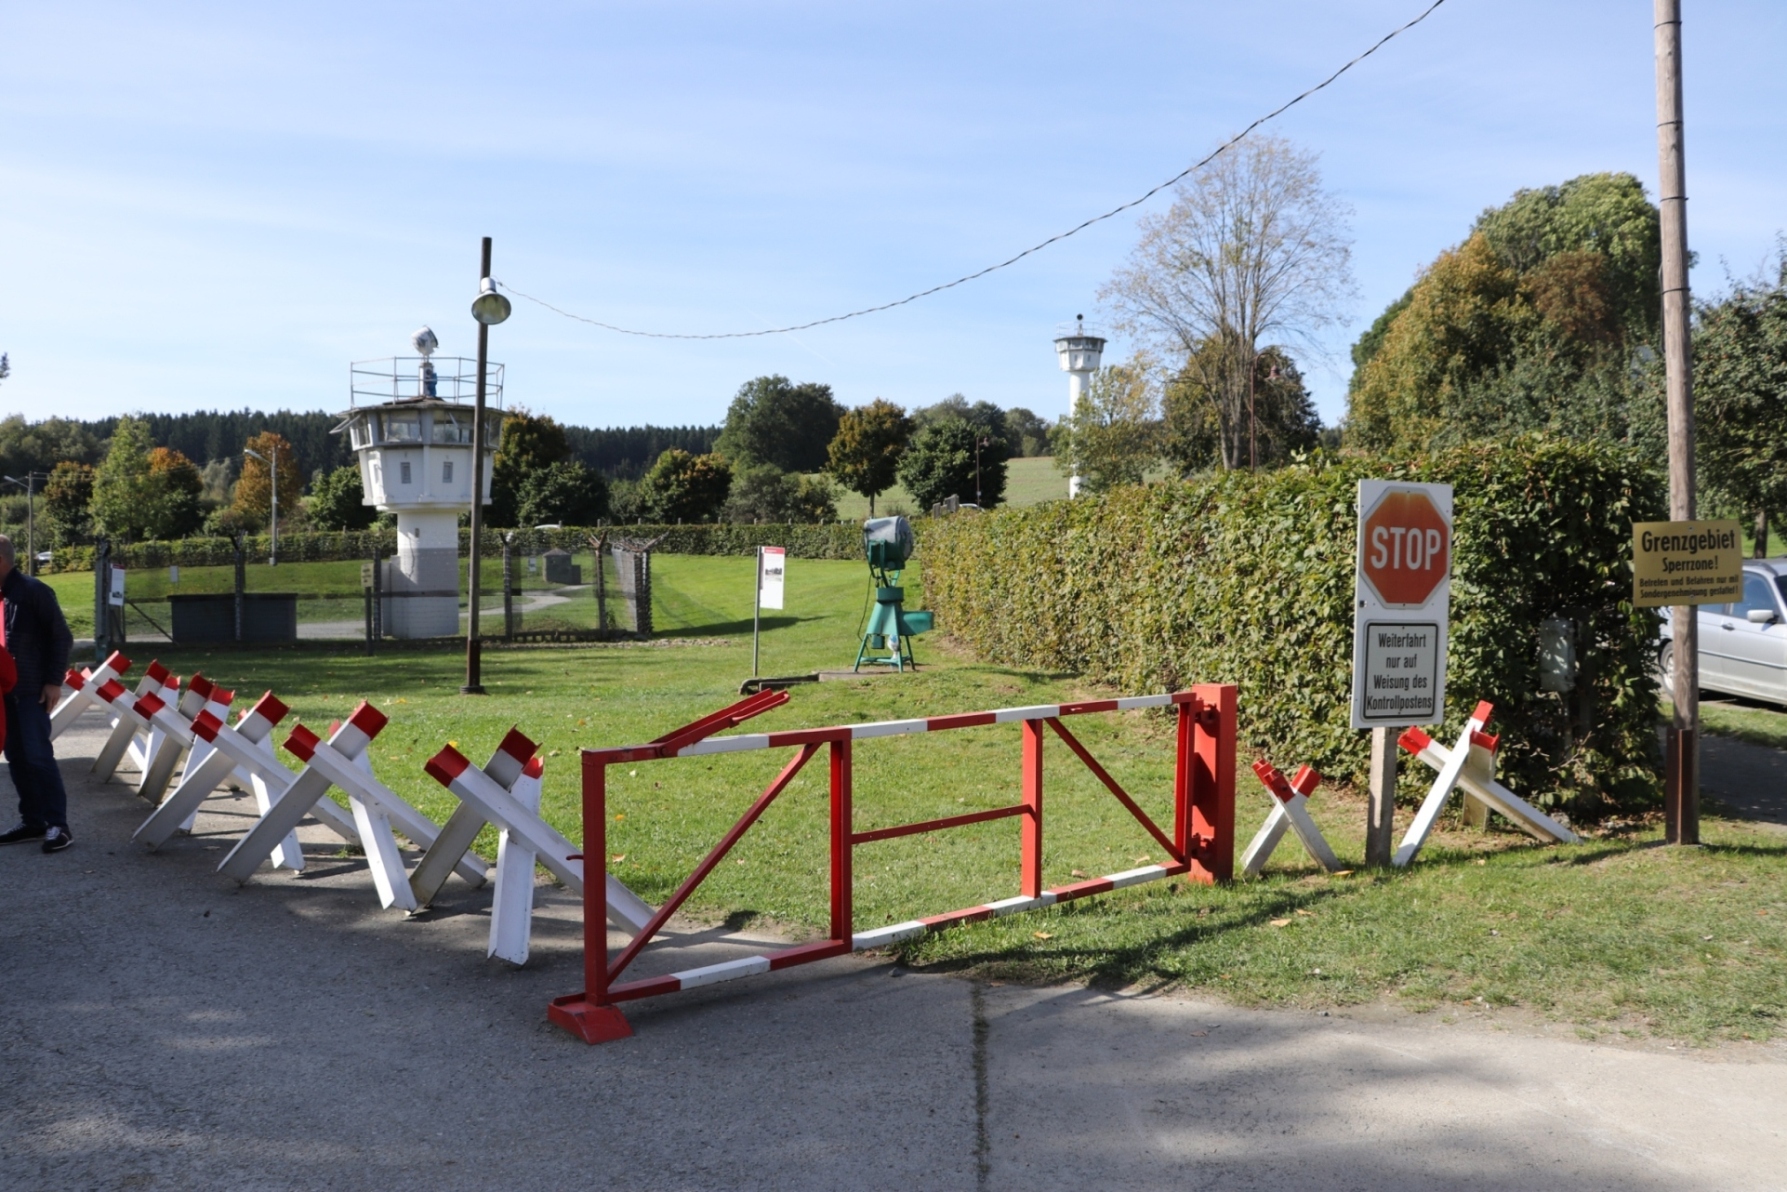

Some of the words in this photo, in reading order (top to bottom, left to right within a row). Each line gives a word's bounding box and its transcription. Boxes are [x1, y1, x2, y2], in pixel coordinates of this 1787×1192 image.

[1371, 526, 1441, 570] STOP
[1641, 528, 1735, 555] Grenzgebiet
[1662, 555, 1718, 574] Sperrzone!
[1640, 578, 1668, 587] Betreten
[1671, 577, 1684, 586] und
[1686, 576, 1714, 585] Befahren
[1716, 576, 1727, 584] nur
[1640, 587, 1708, 599] Sondergenehmigung
[1378, 633, 1427, 648] Weiterfahrt
[1385, 656, 1401, 668] nur
[1403, 653, 1417, 668] auf
[1373, 674, 1410, 691] Weisung
[1412, 674, 1428, 689] des
[1366, 695, 1432, 711] Kontrollpostens
